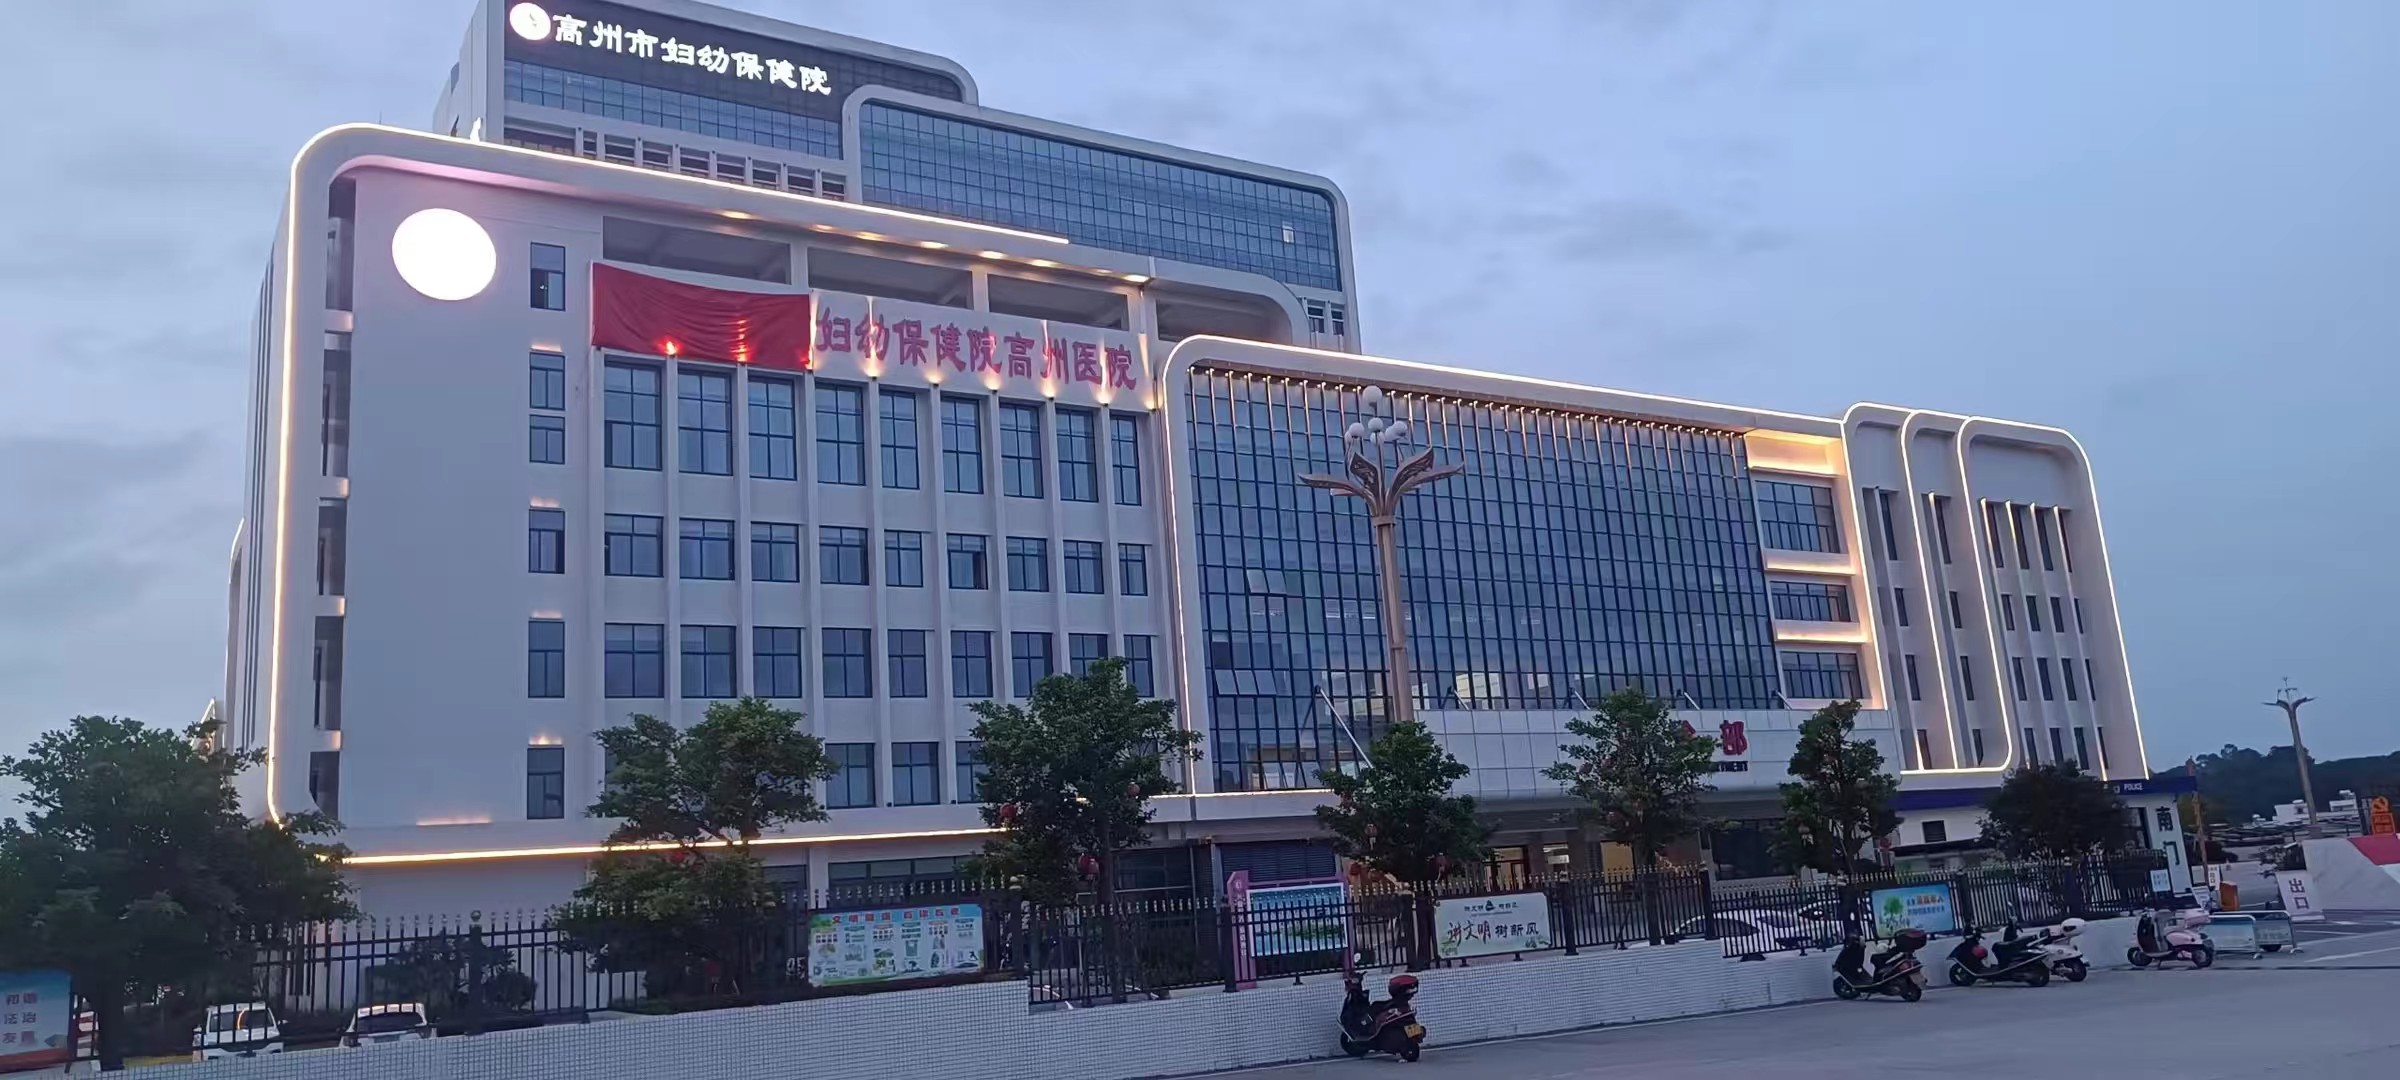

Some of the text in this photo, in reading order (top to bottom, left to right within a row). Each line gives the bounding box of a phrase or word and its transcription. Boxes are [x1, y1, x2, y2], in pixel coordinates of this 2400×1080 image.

[552, 14, 832, 96] 高州市妇幼保健院
[816, 306, 1137, 391] 妇幼保健院高州医院
[2123, 782, 2144, 791] POLICE
[2156, 807, 2179, 865] 南门
[2288, 877, 2310, 910] 出口
